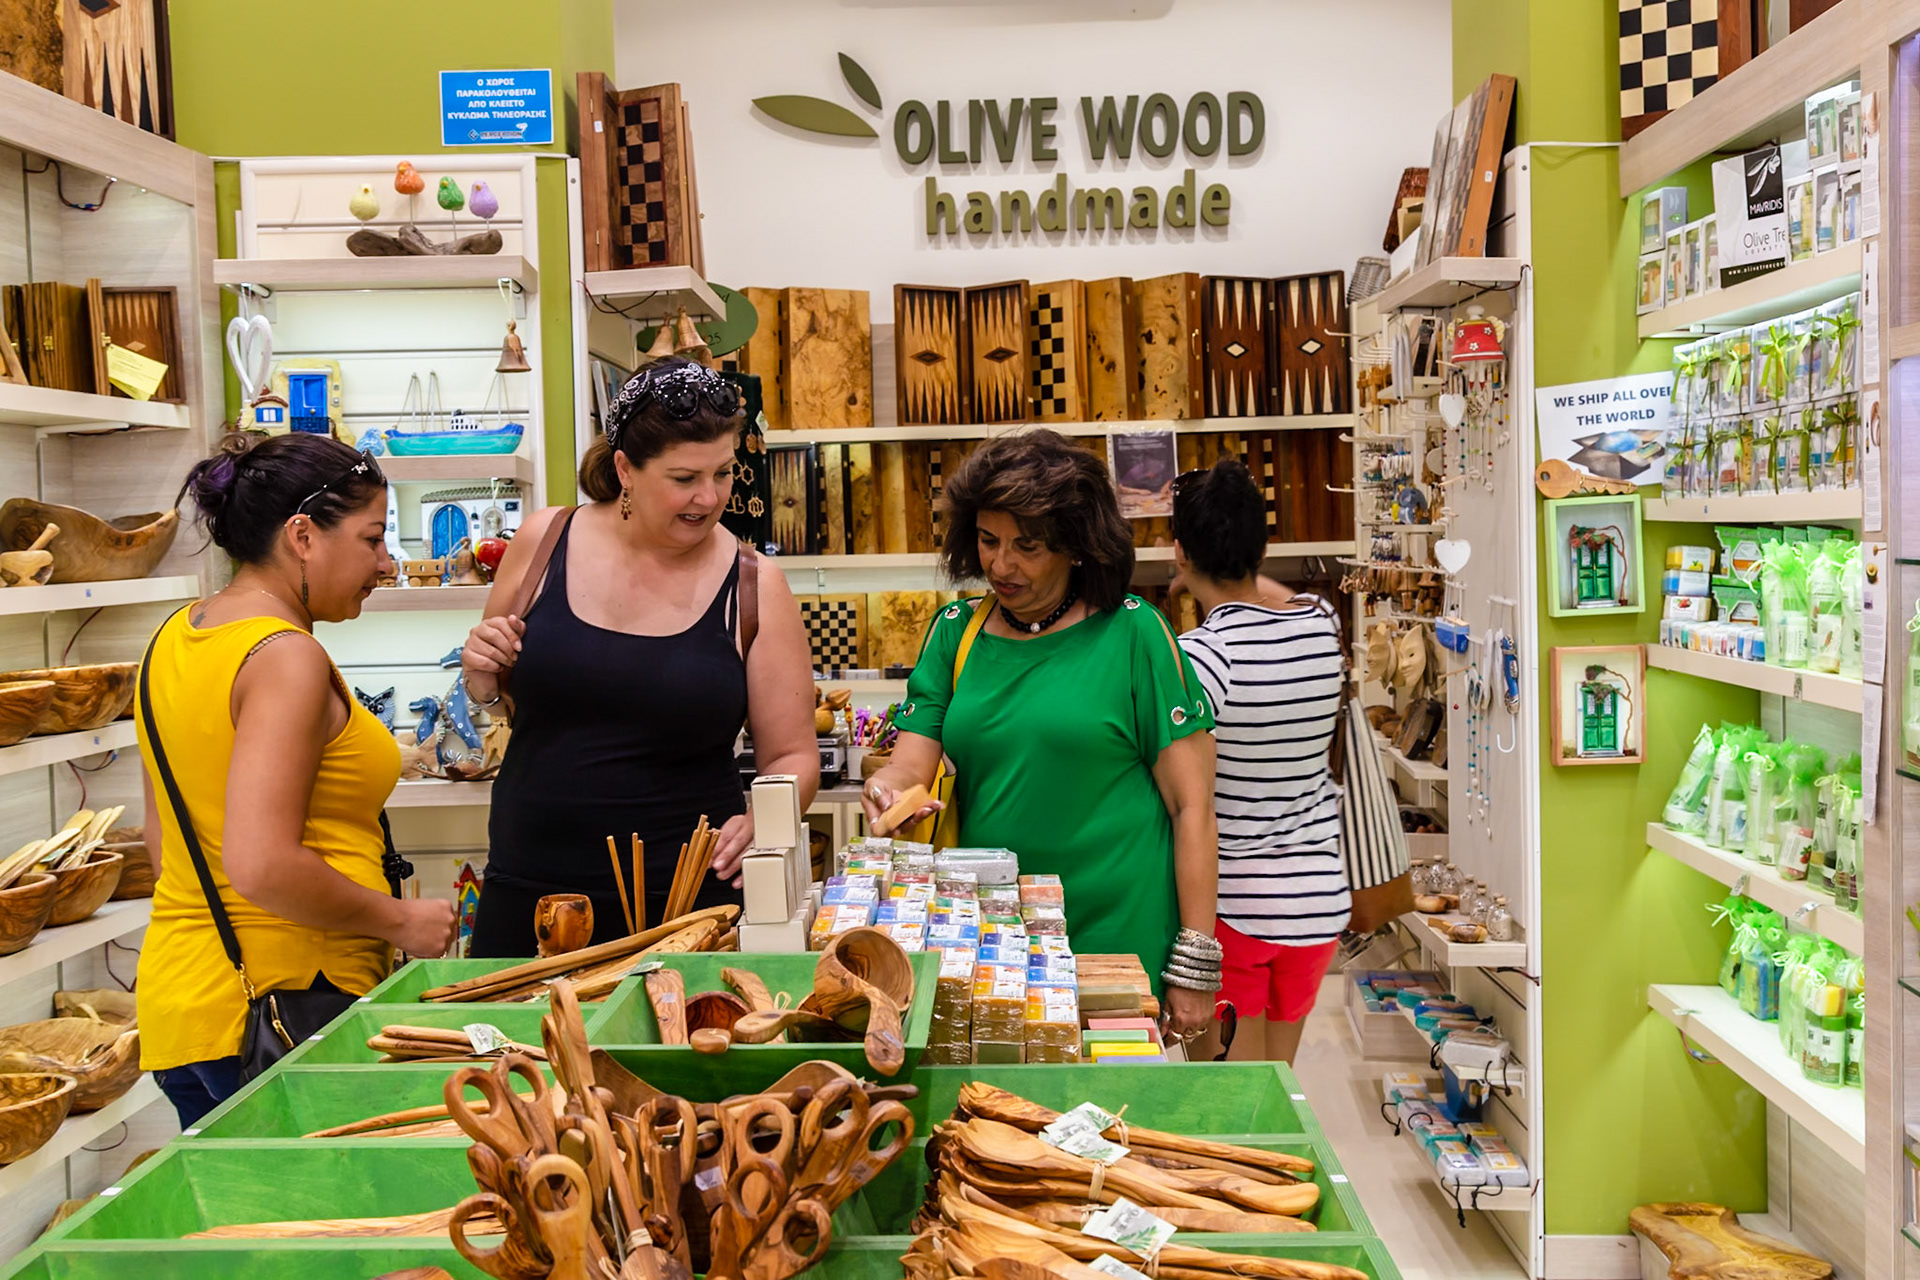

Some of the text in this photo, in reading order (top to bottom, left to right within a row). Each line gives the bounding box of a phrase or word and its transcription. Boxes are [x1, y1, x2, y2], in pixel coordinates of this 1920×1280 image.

[486, 78, 515, 86] ΧΩΡΟΣ
[456, 88, 536, 98] ΠΑΡΑΚΟΛΟΥΘΕΙΤΑΙ
[468, 100, 525, 108] ΑΠΟ ΚΛΕΙΣΤΟ
[447, 110, 546, 120] ΚΥΚΛΩΜΑ ΤΗΛΕΟΡΑΣΗΣ
[894, 91, 1266, 165] OLIVE WOOD
[925, 168, 1231, 235] handmade
[1749, 198, 1783, 215] MAVRIDIS
[1744, 233, 1769, 248] Olive
[1553, 396, 1575, 408] WE
[1578, 392, 1609, 406] SHIP
[1612, 390, 1637, 402] ALL
[1576, 408, 1655, 426] THE WORLD
